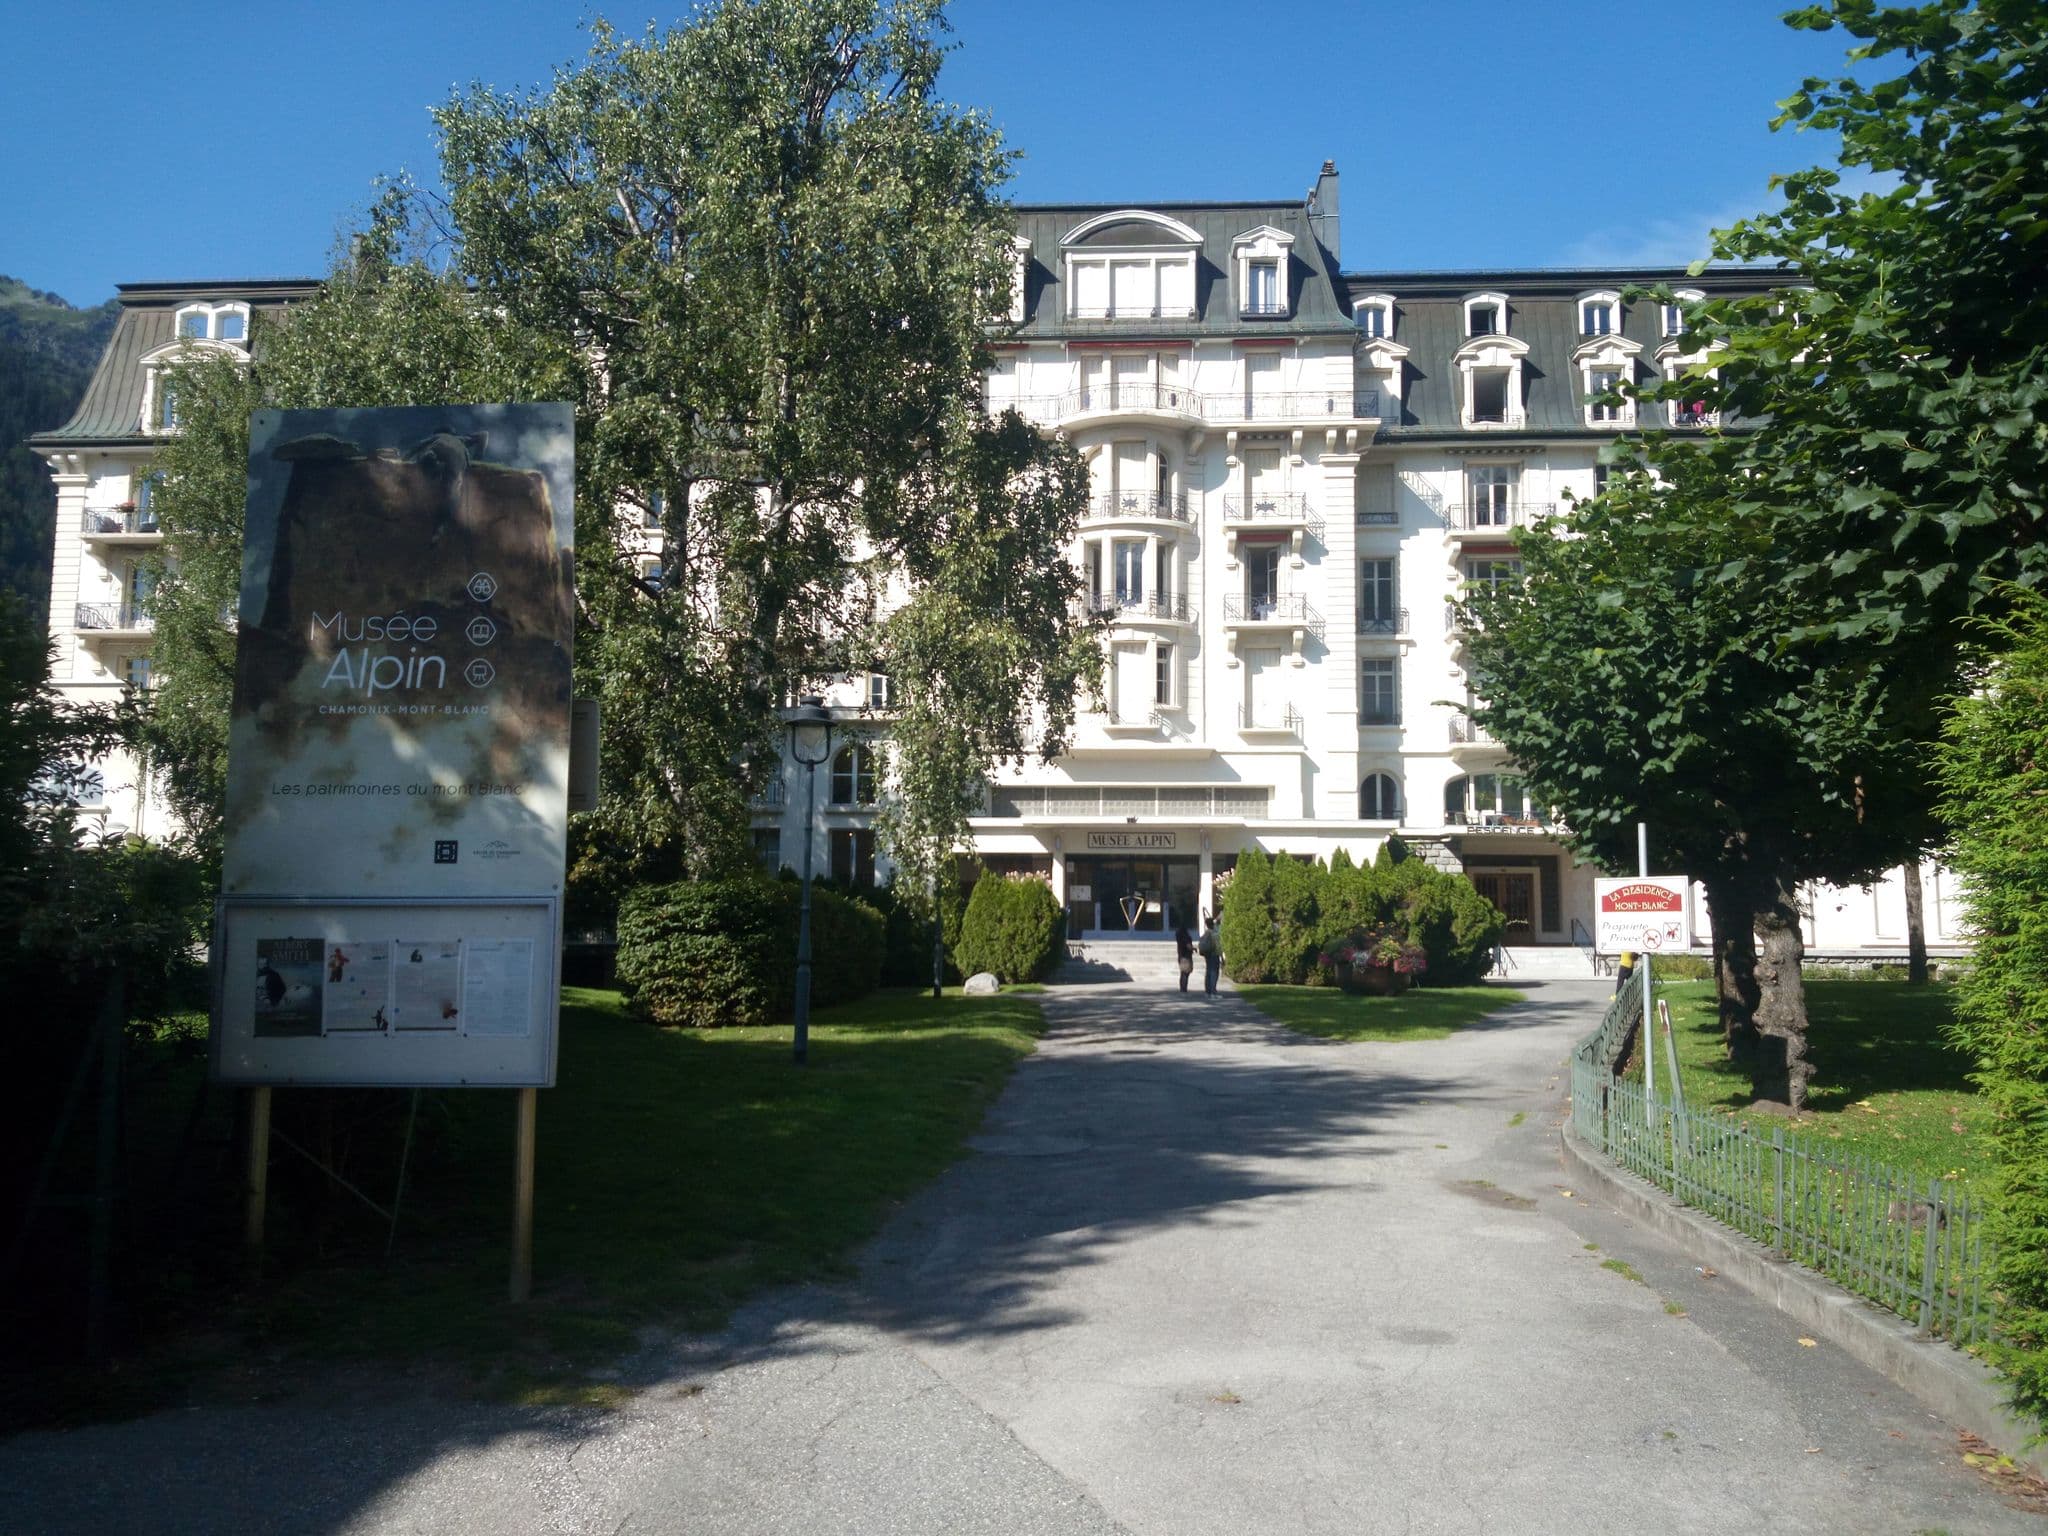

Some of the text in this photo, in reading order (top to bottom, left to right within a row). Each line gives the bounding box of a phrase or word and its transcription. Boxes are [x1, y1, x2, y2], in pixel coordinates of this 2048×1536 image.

[310, 610, 438, 642] Musée
[321, 646, 447, 699] Alpin
[271, 783, 523, 799] Les patrimoines du mont Blanc
[1136, 834, 1172, 846] ALPIN
[1609, 893, 1621, 902] LA
[1615, 901, 1669, 911] MONT-BLANC
